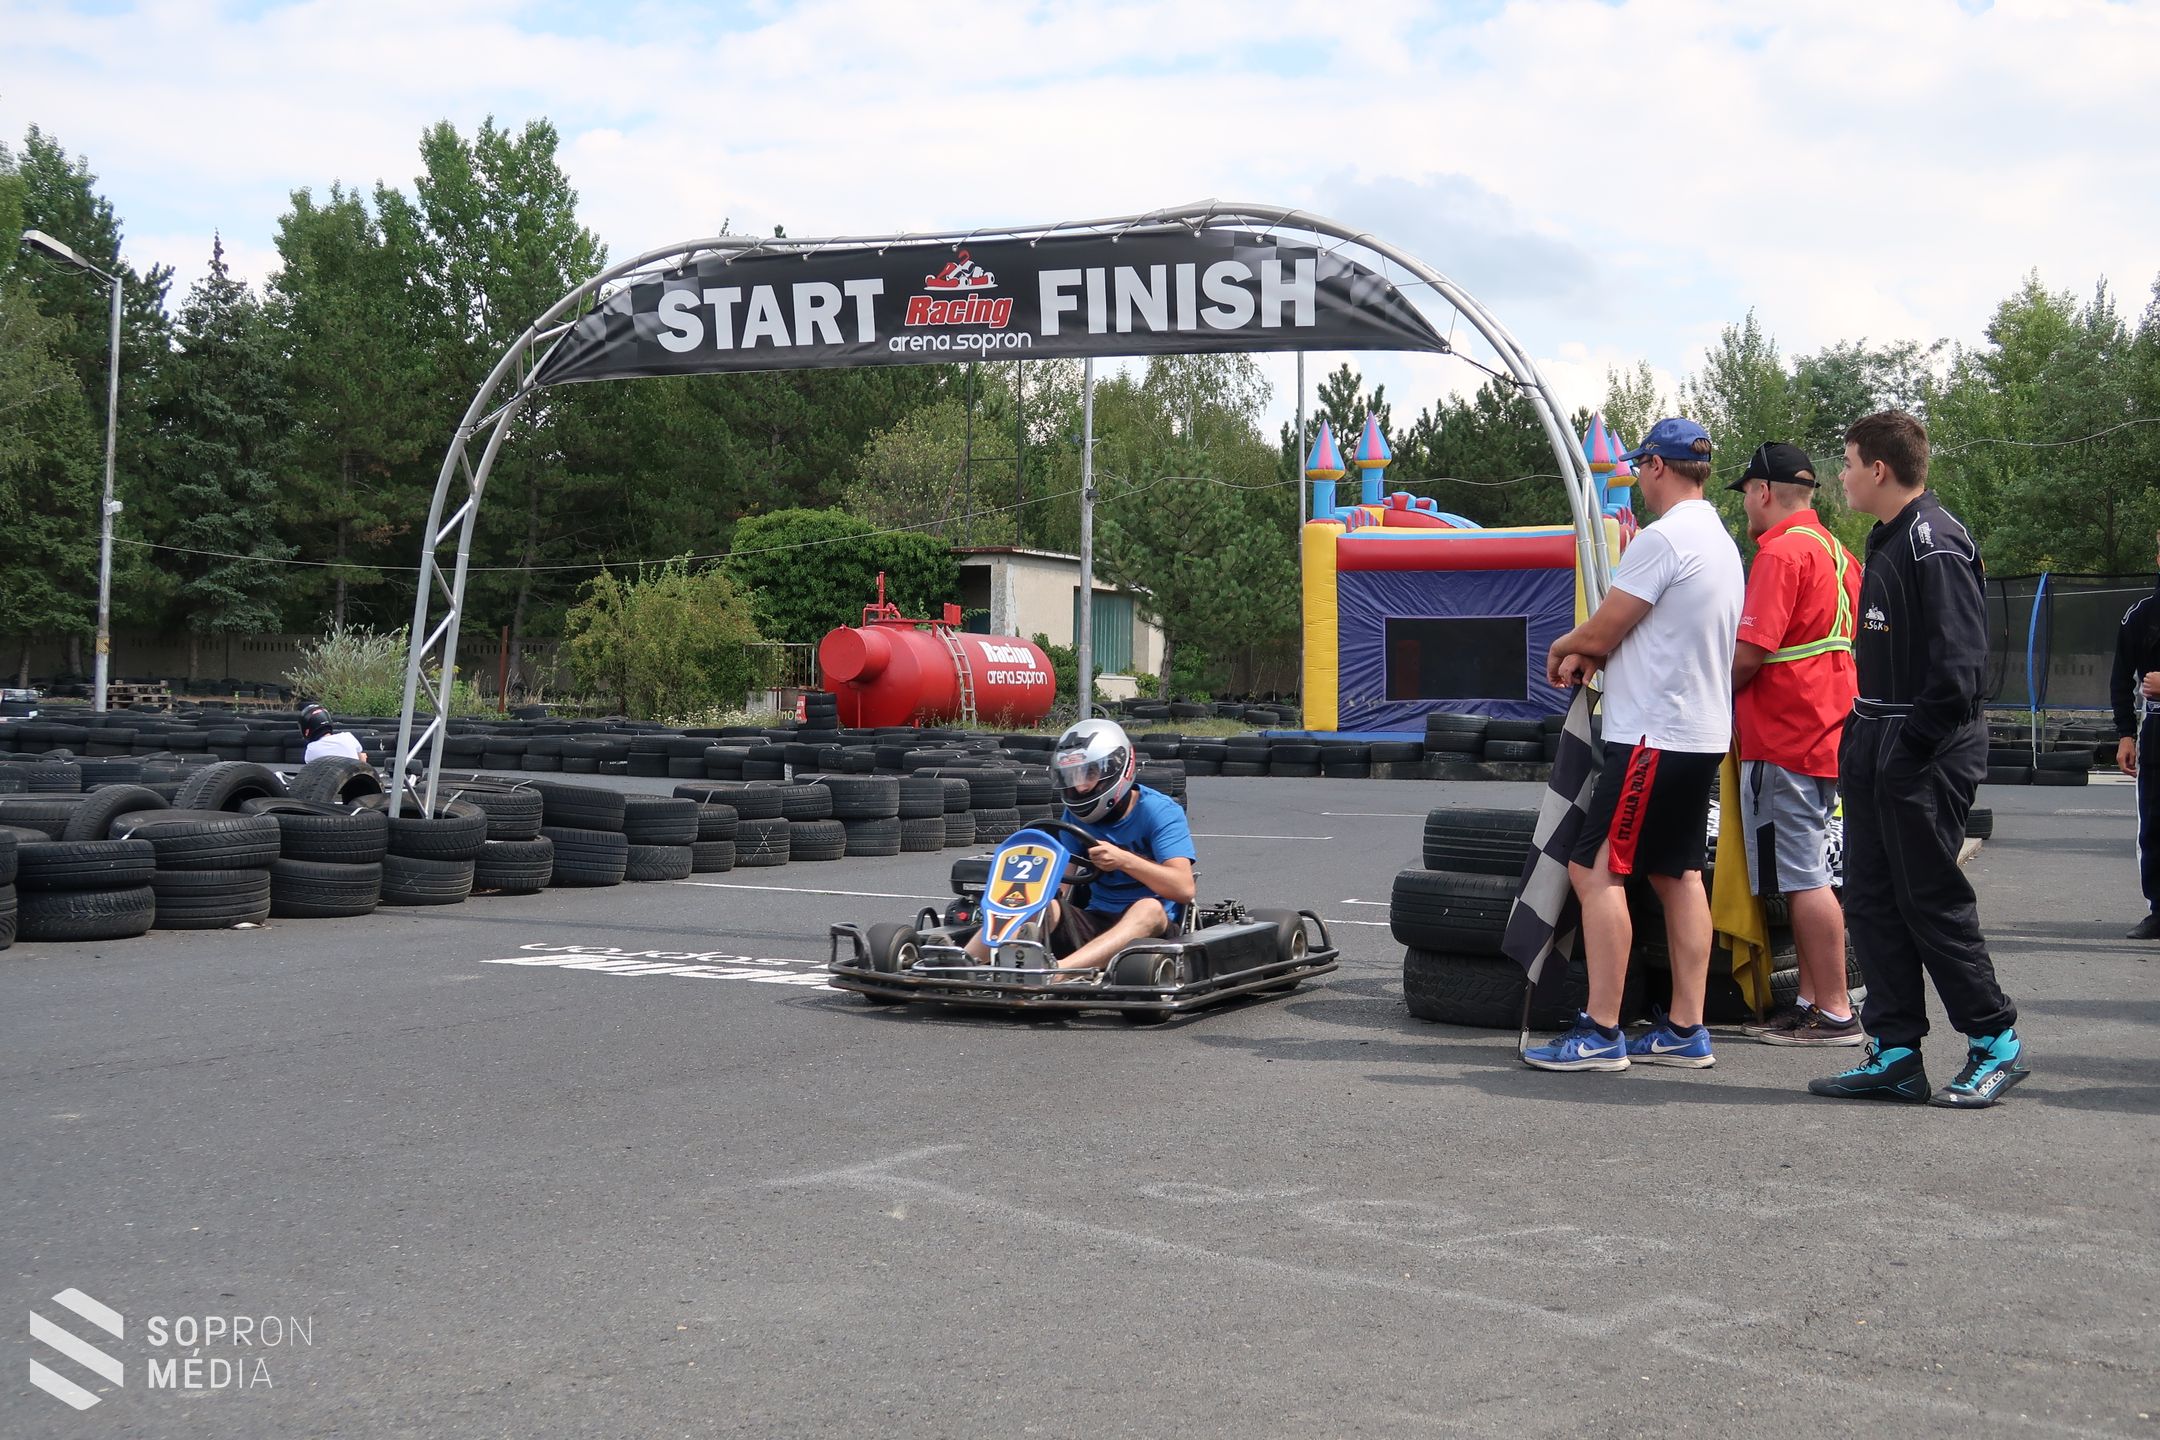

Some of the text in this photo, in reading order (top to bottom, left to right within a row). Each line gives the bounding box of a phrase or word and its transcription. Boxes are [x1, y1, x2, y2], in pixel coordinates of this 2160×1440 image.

[904, 293, 1014, 329] Racing
[1038, 258, 1317, 336] FINISH
[657, 278, 885, 353] START
[977, 640, 1037, 669] Racing
[1013, 860, 1034, 880] 2
[478, 953, 850, 992] acing
[1978, 1070, 2006, 1097] sparco
